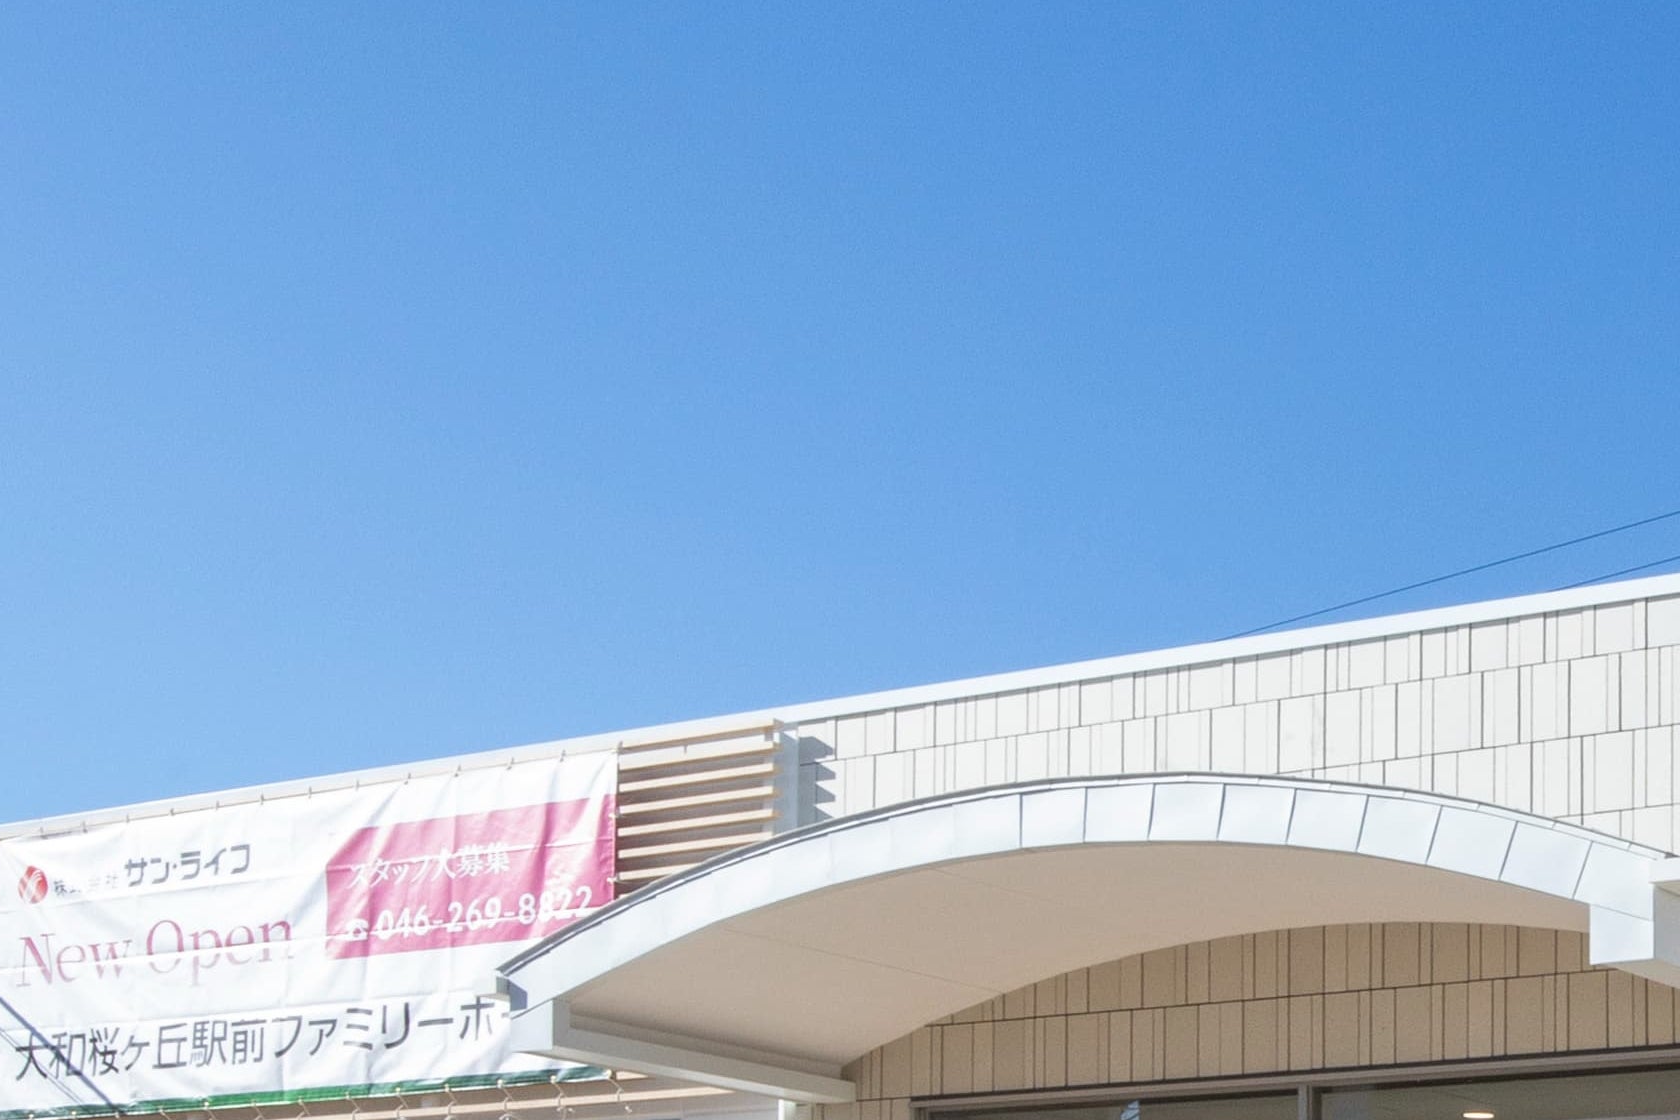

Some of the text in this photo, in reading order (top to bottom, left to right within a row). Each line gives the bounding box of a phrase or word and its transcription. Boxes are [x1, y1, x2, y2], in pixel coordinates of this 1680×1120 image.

[346, 841, 510, 889] スタッフ大募集
[375, 885, 593, 939] 046-269-8822
[17, 919, 295, 987] New Open
[16, 995, 511, 1082] 大和桜ヶ丘駅前ファミリーホ
